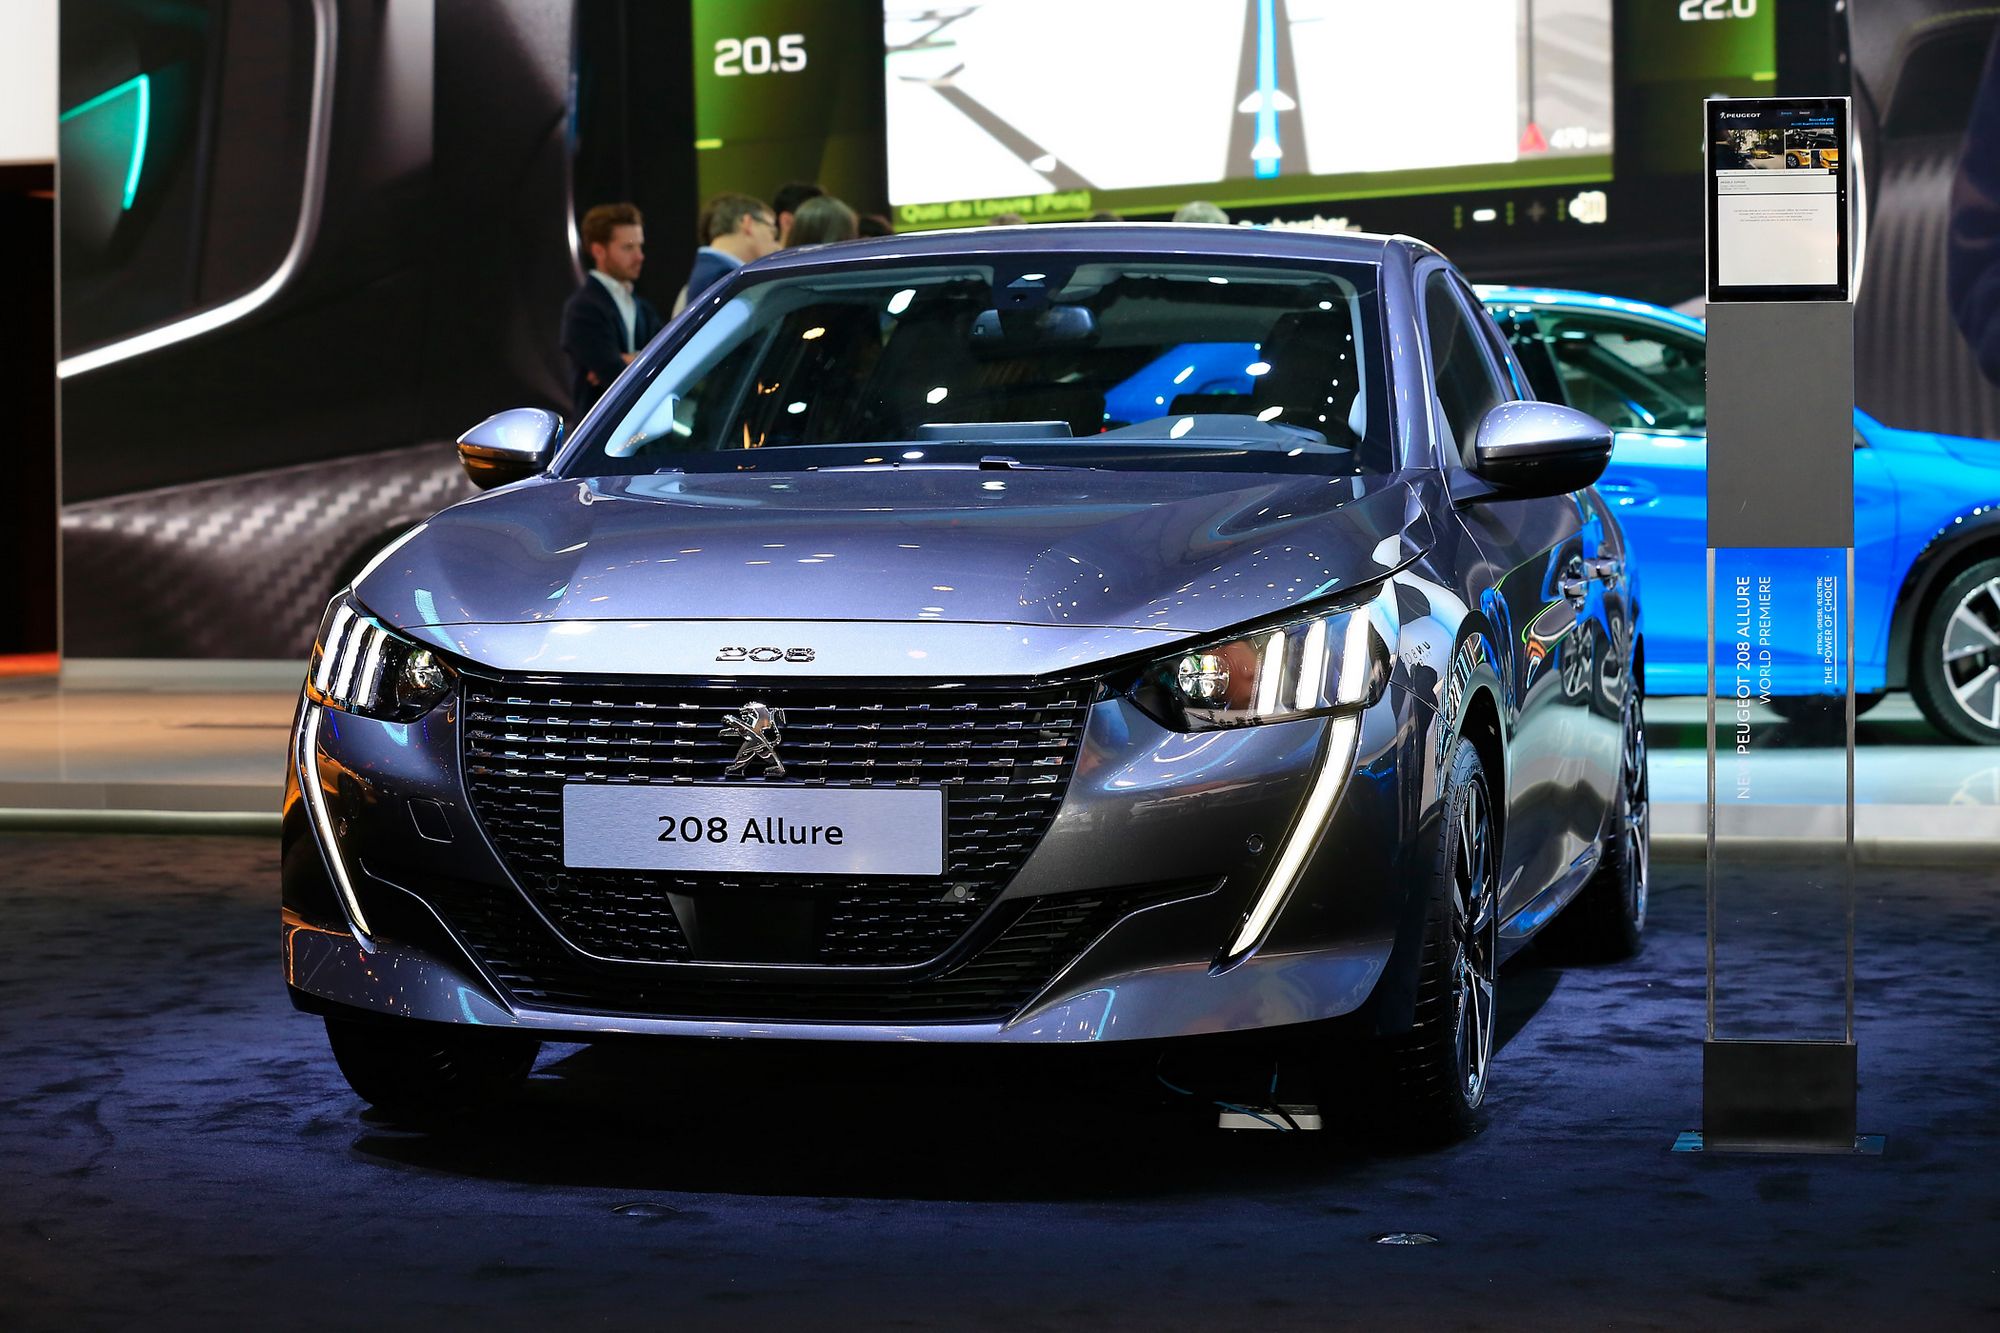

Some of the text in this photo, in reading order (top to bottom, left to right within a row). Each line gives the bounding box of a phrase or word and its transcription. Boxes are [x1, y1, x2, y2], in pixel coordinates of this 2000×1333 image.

[714, 34, 807, 76] 20.5
[1736, 576, 1751, 638] ALLURE
[1824, 576, 1833, 685] THE POWER OF CHOICE
[715, 646, 816, 663] 208
[1736, 641, 1751, 671] 208
[1759, 576, 1772, 705] WORLD PREMIERE
[1736, 675, 1751, 755] PEUGEOT
[657, 815, 844, 845] 208 Allure
